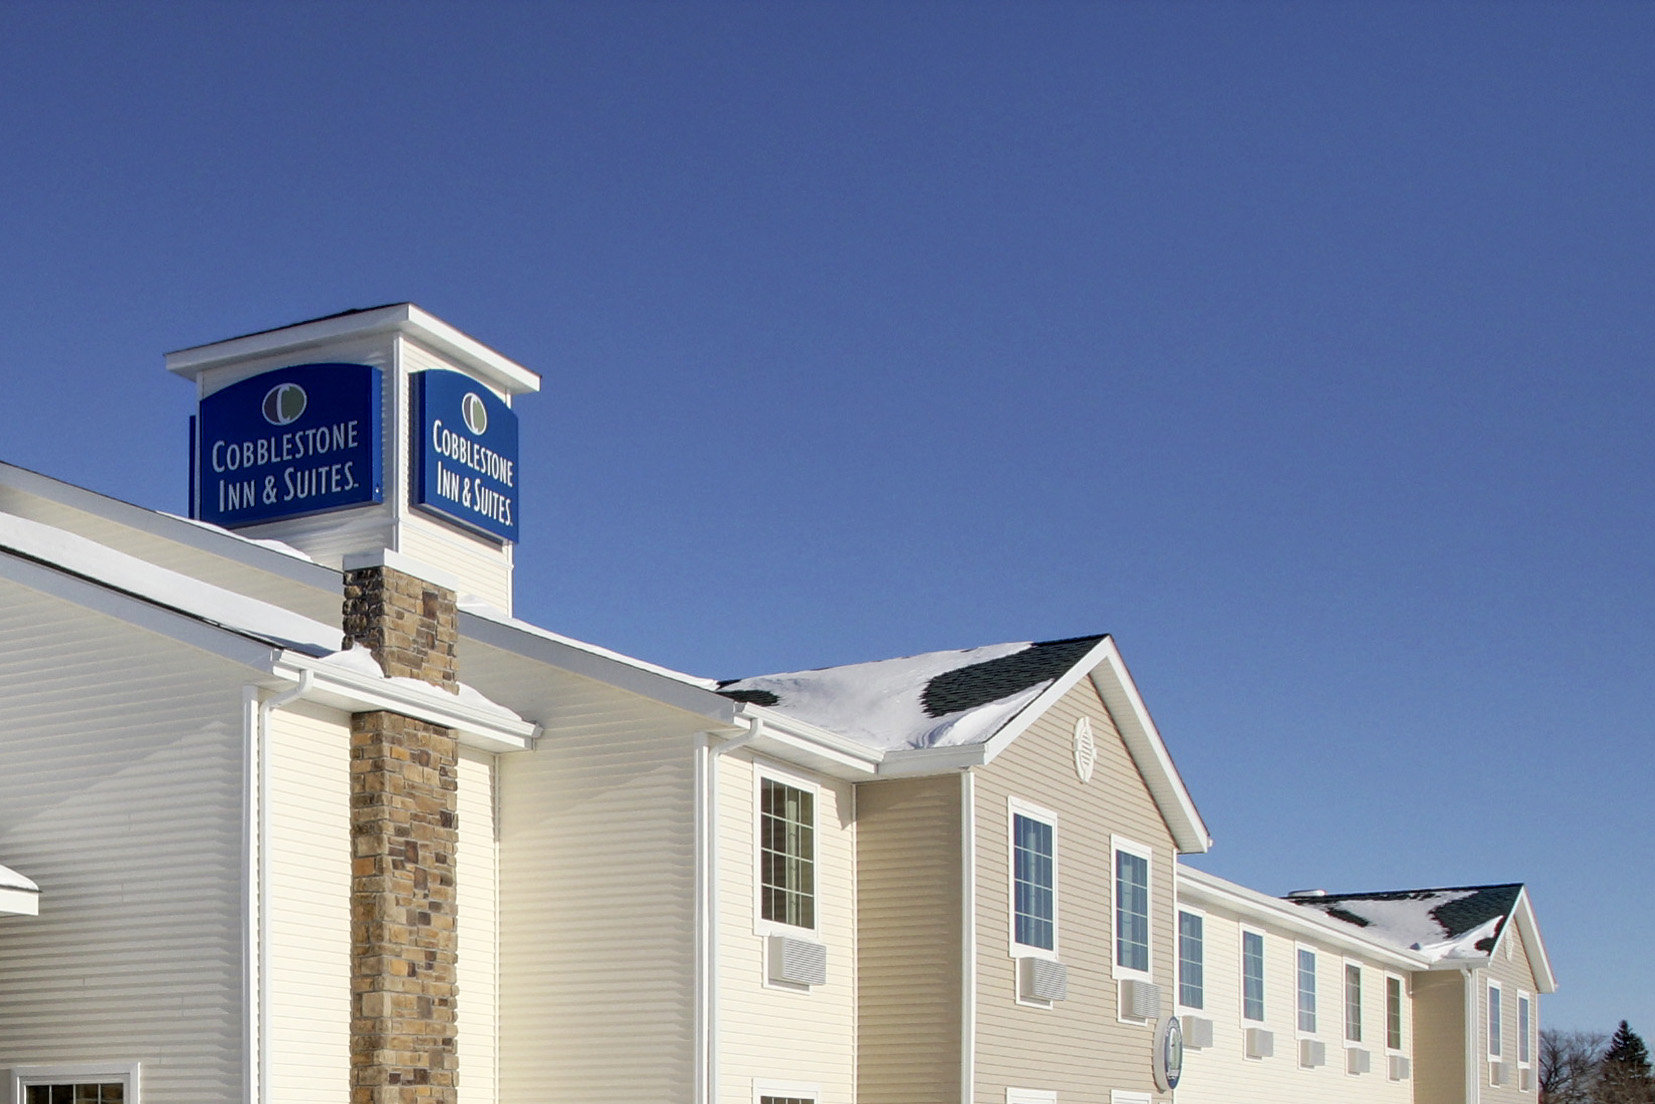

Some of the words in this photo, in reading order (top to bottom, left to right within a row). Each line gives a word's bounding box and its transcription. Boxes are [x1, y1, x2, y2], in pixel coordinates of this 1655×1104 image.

[212, 420, 358, 473] COBBLESTONE
[433, 419, 513, 488] COBBLESTONE
[219, 479, 256, 513] INN
[262, 475, 277, 505] &
[283, 461, 354, 501] SUITES
[437, 461, 460, 503] INN
[462, 477, 472, 508] &
[474, 478, 512, 526] SUITES
